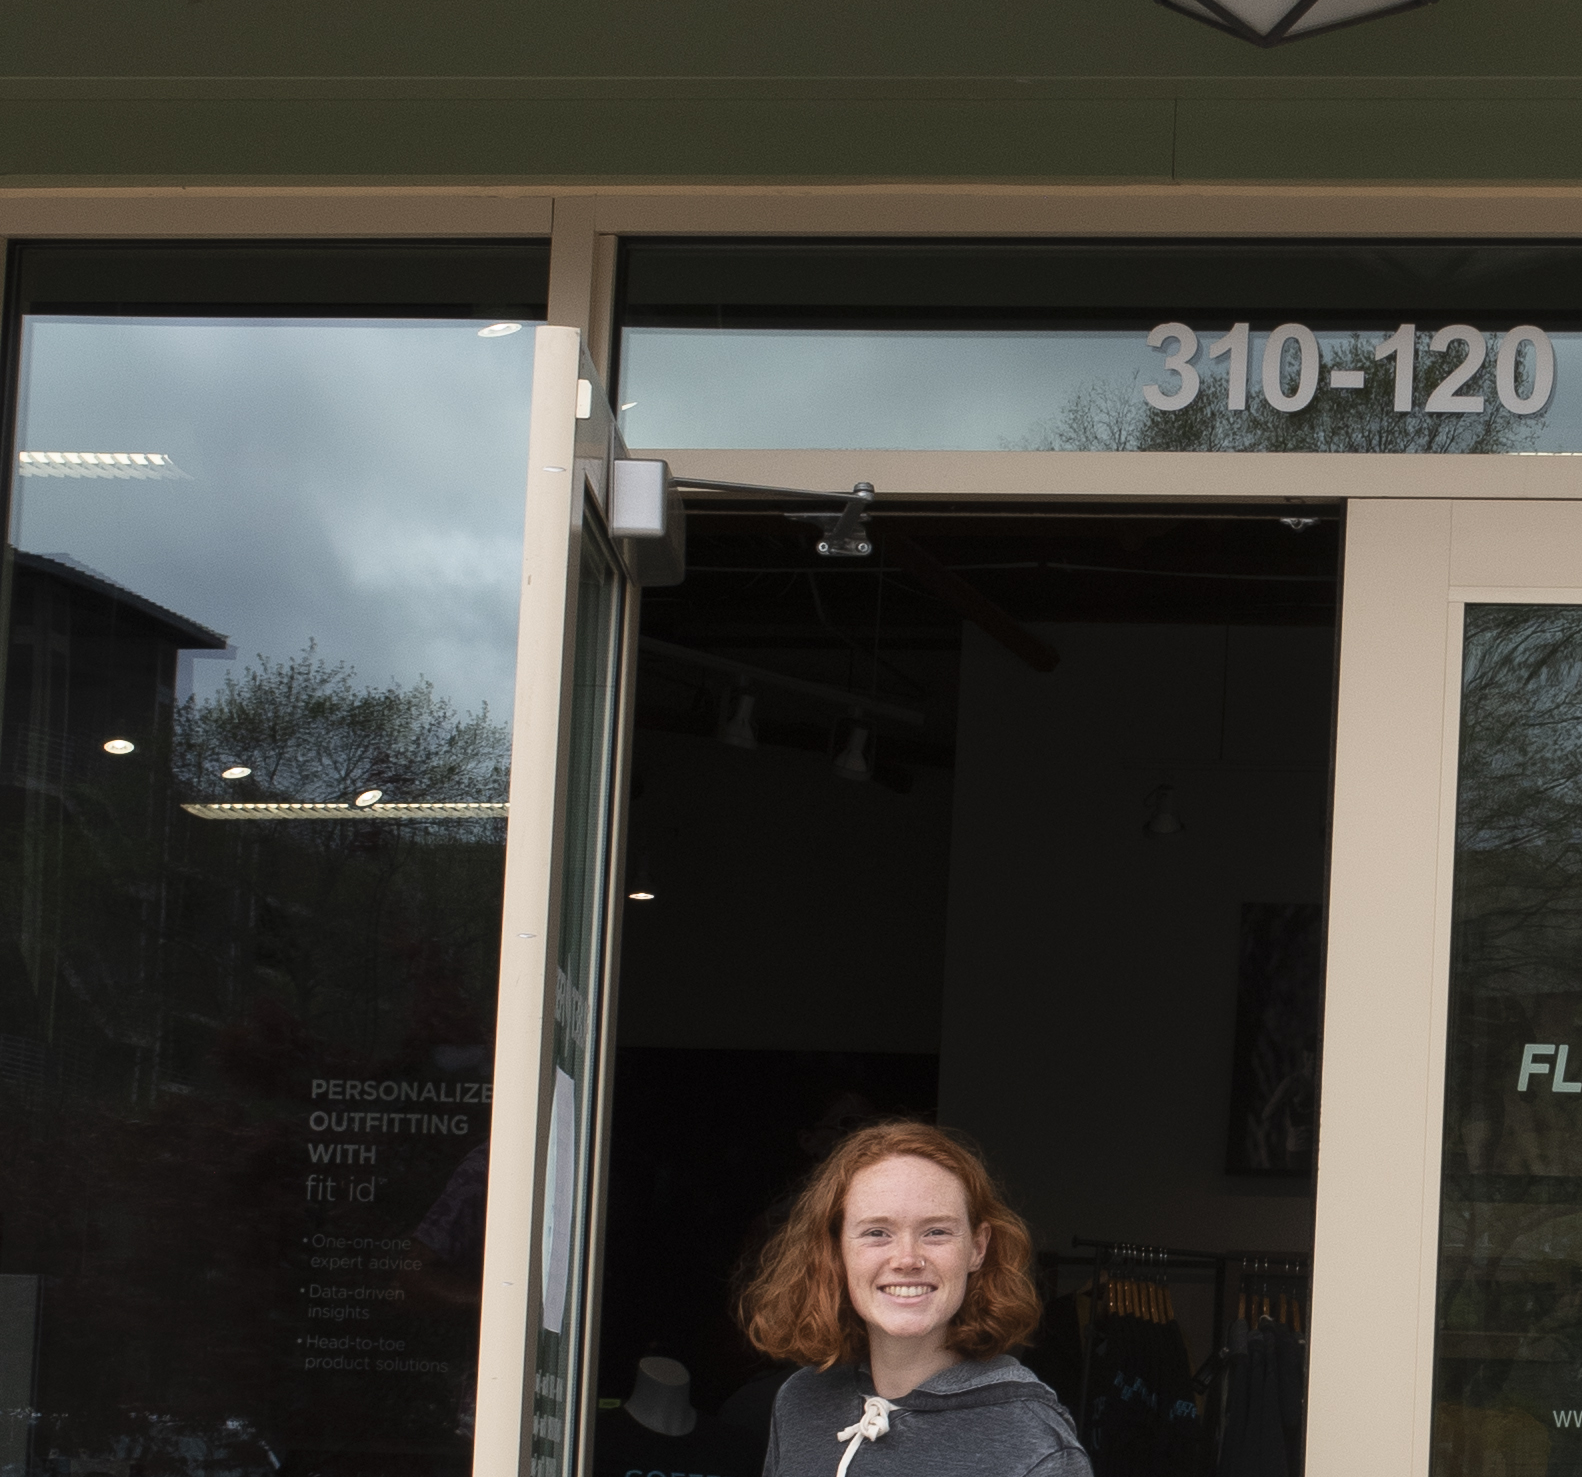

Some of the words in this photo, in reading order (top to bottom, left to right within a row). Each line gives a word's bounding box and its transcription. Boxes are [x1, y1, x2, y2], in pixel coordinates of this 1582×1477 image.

[1141, 321, 1555, 414] 310-120
[309, 1110, 468, 1135] OUTFITTING
[308, 1142, 376, 1164] WITH
[305, 1174, 337, 1201] fit
[348, 1175, 375, 1202] id
[311, 1233, 412, 1251] One-on-one
[310, 1256, 364, 1271] expert
[368, 1255, 423, 1271] advice
[309, 1283, 405, 1301] Data-driven
[307, 1304, 370, 1322] insights
[306, 1334, 406, 1352] Head-to-toe
[304, 1354, 371, 1372] product
[375, 1356, 449, 1373] solutions
